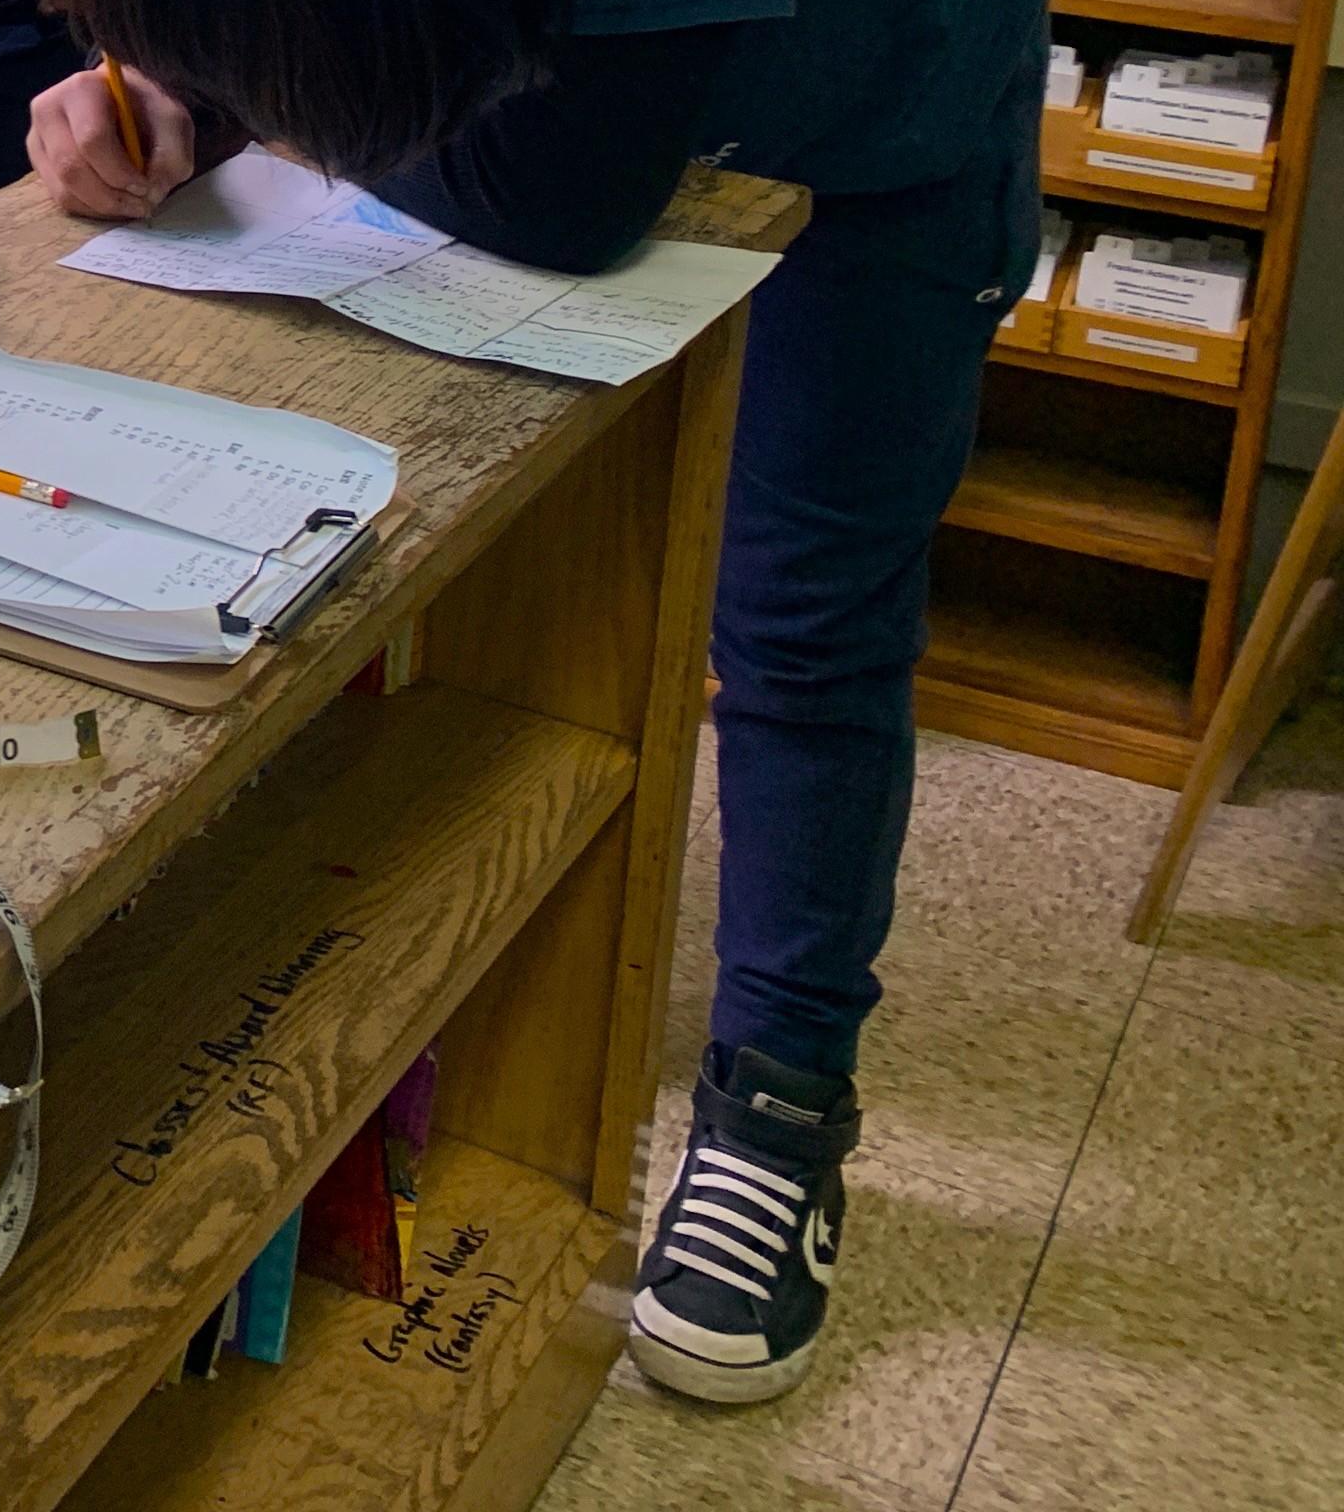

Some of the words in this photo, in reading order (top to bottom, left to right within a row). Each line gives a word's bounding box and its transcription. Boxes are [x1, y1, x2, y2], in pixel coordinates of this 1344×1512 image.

[362, 1282, 447, 1364] Graphic
[422, 1223, 490, 1278] Novels
[424, 1272, 524, 1374] (Fantasy)
